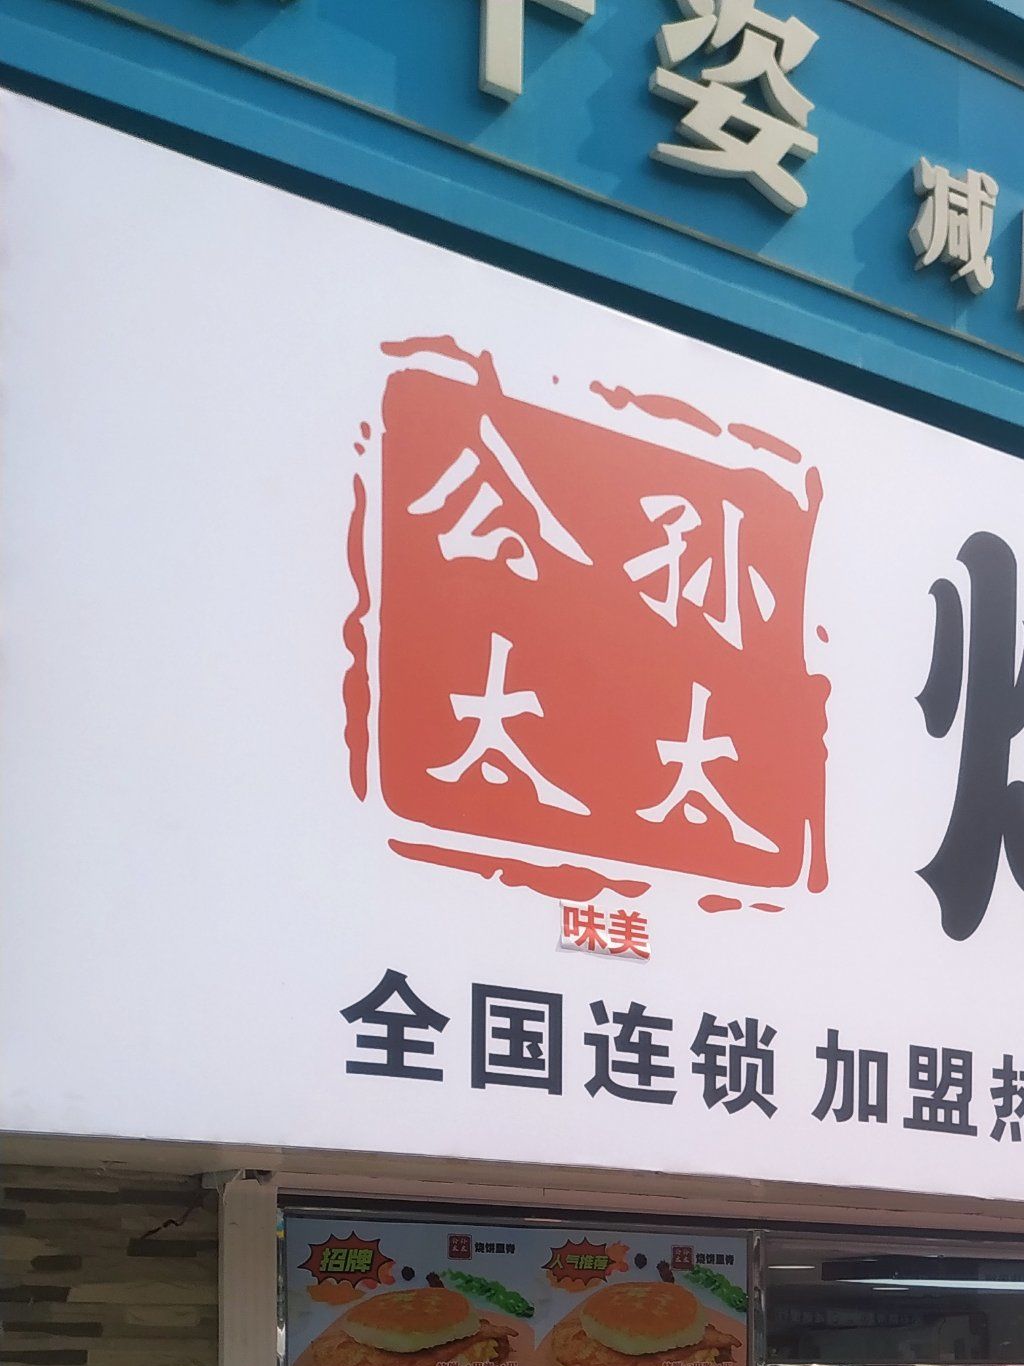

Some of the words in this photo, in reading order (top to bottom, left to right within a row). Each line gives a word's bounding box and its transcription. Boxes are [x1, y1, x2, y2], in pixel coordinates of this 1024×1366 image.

[407, 413, 776, 650] 公孙
[426, 631, 780, 853] 太太
[563, 903, 651, 960] 味美
[340, 968, 778, 1119] 全国连锁
[319, 1247, 375, 1273] 招牌
[549, 1254, 610, 1271] 人气推荐
